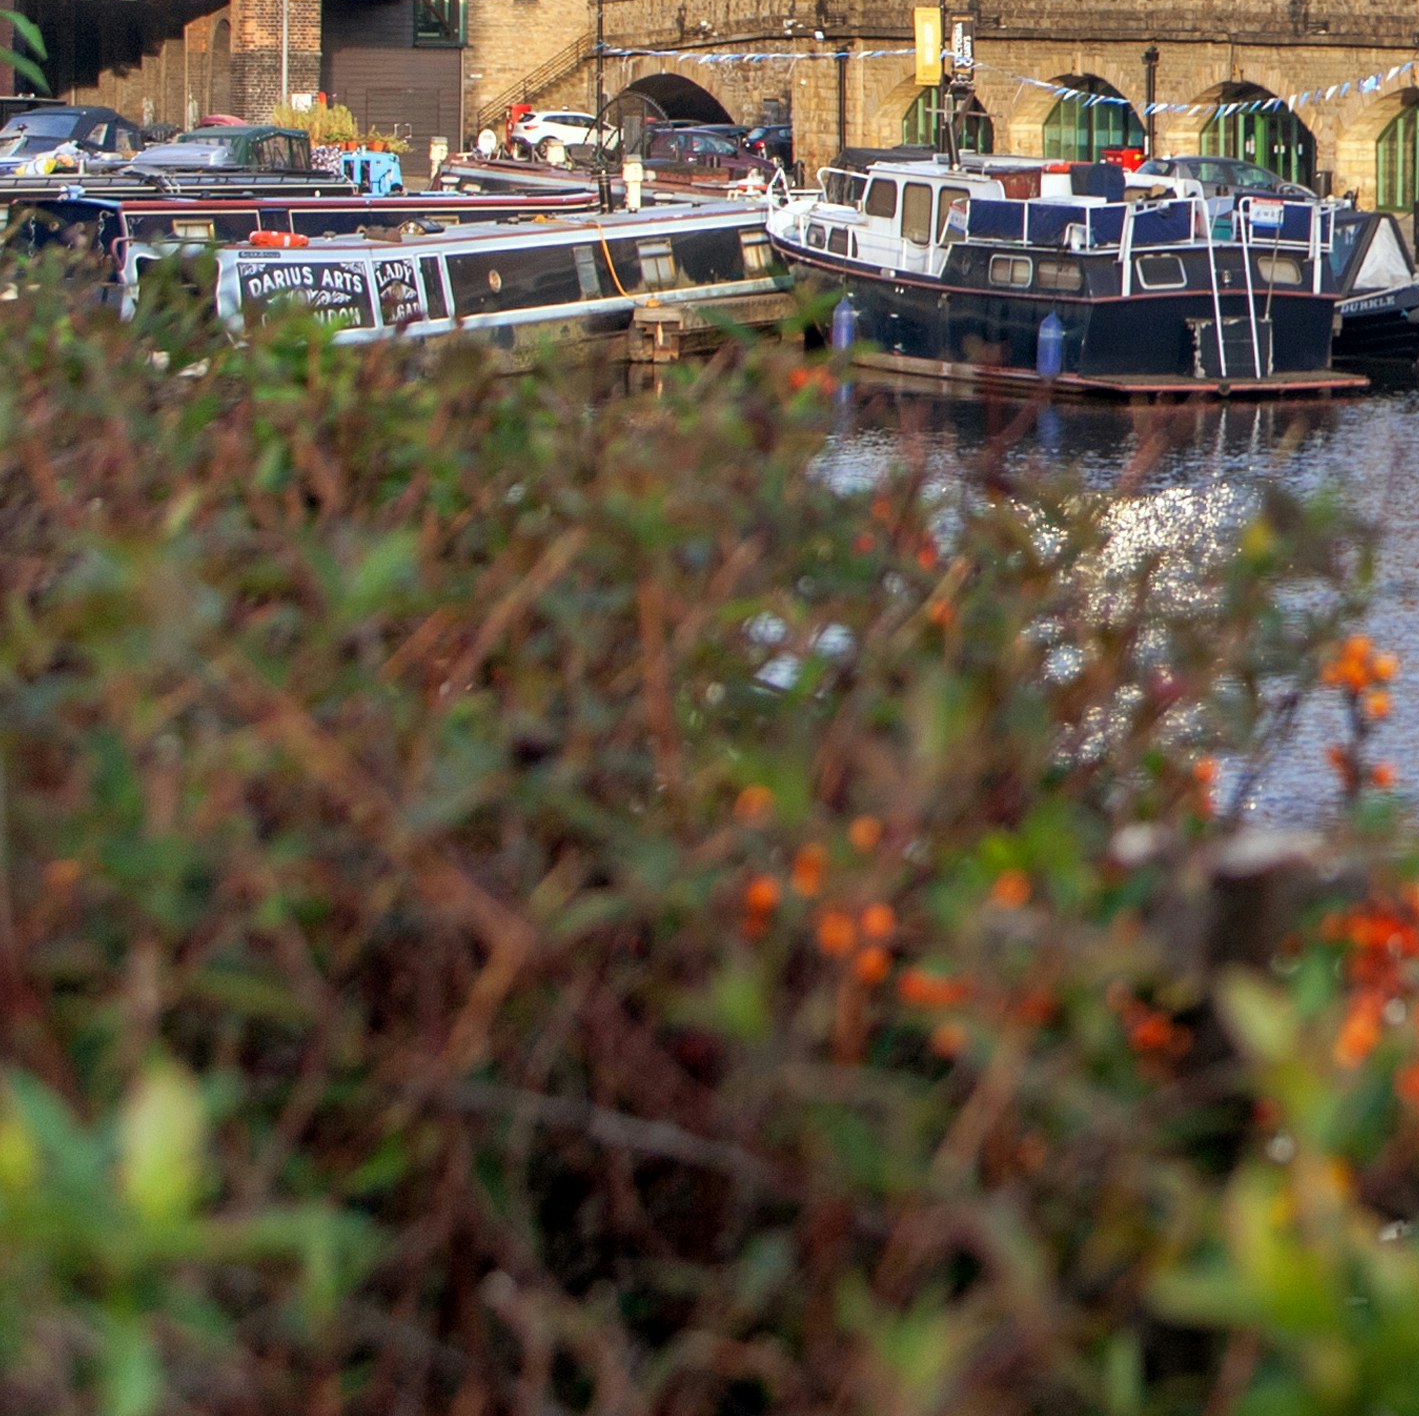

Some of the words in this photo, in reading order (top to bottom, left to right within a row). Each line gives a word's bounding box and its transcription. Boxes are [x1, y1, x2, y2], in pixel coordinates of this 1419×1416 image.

[248, 266, 314, 297] DARIUS
[321, 268, 363, 294] ARTS
[375, 262, 412, 288] LADY
